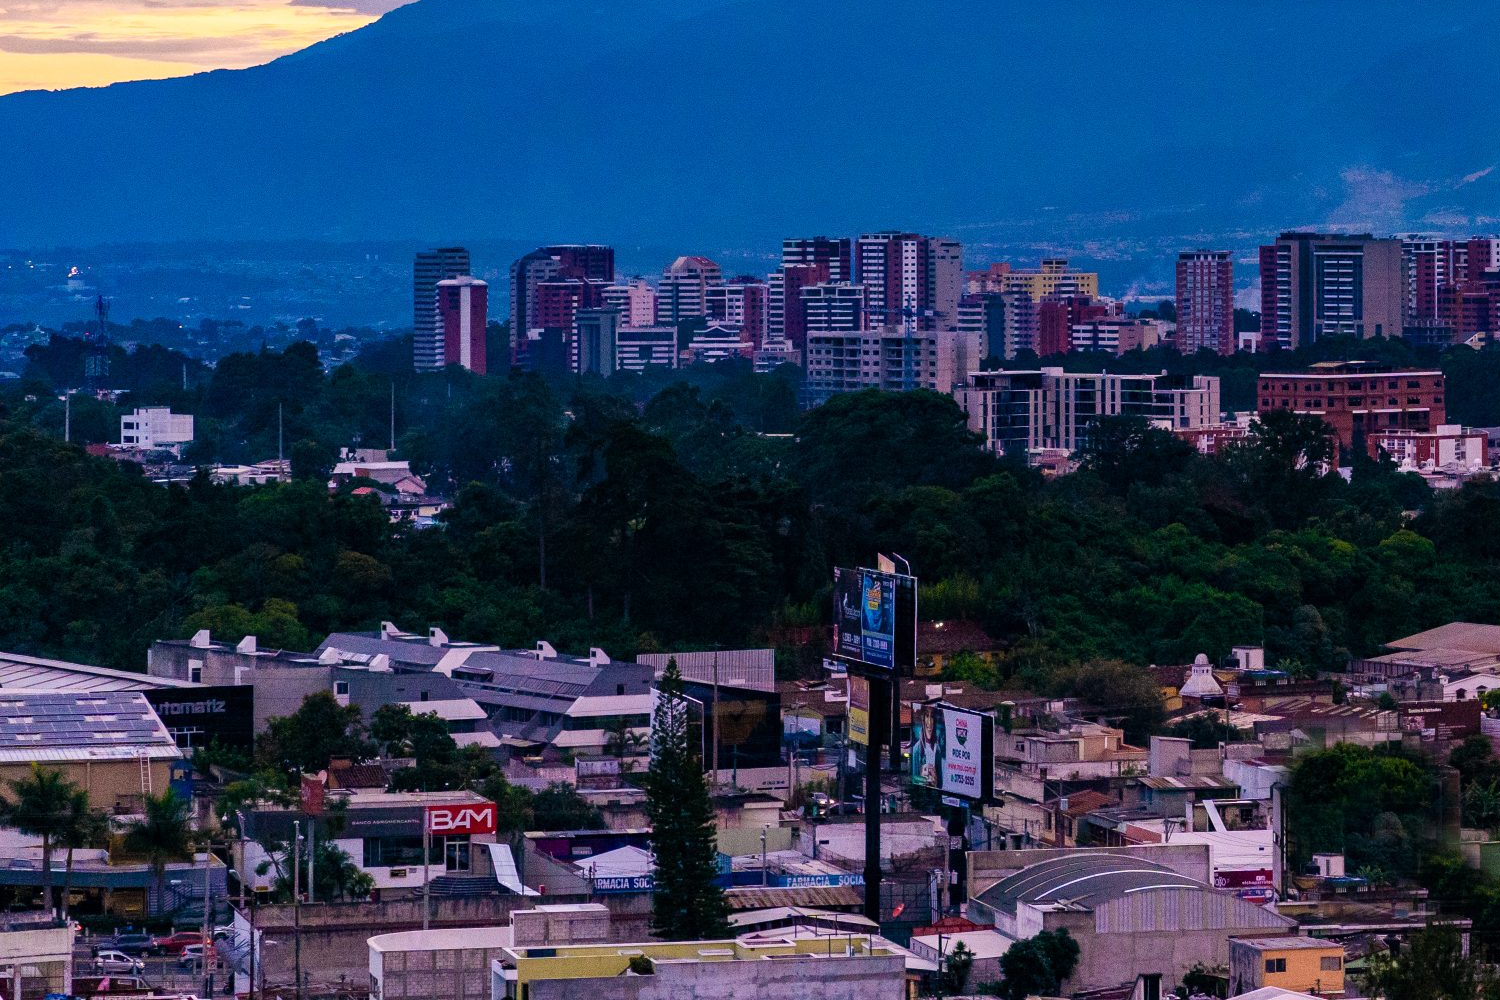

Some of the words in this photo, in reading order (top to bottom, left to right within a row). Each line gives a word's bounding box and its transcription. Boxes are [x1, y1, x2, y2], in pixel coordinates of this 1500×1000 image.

[153, 699, 226, 716] utomatiz
[432, 808, 492, 830] BAM
[787, 876, 830, 888] FARMACIA
[838, 875, 866, 886] SOCIA
